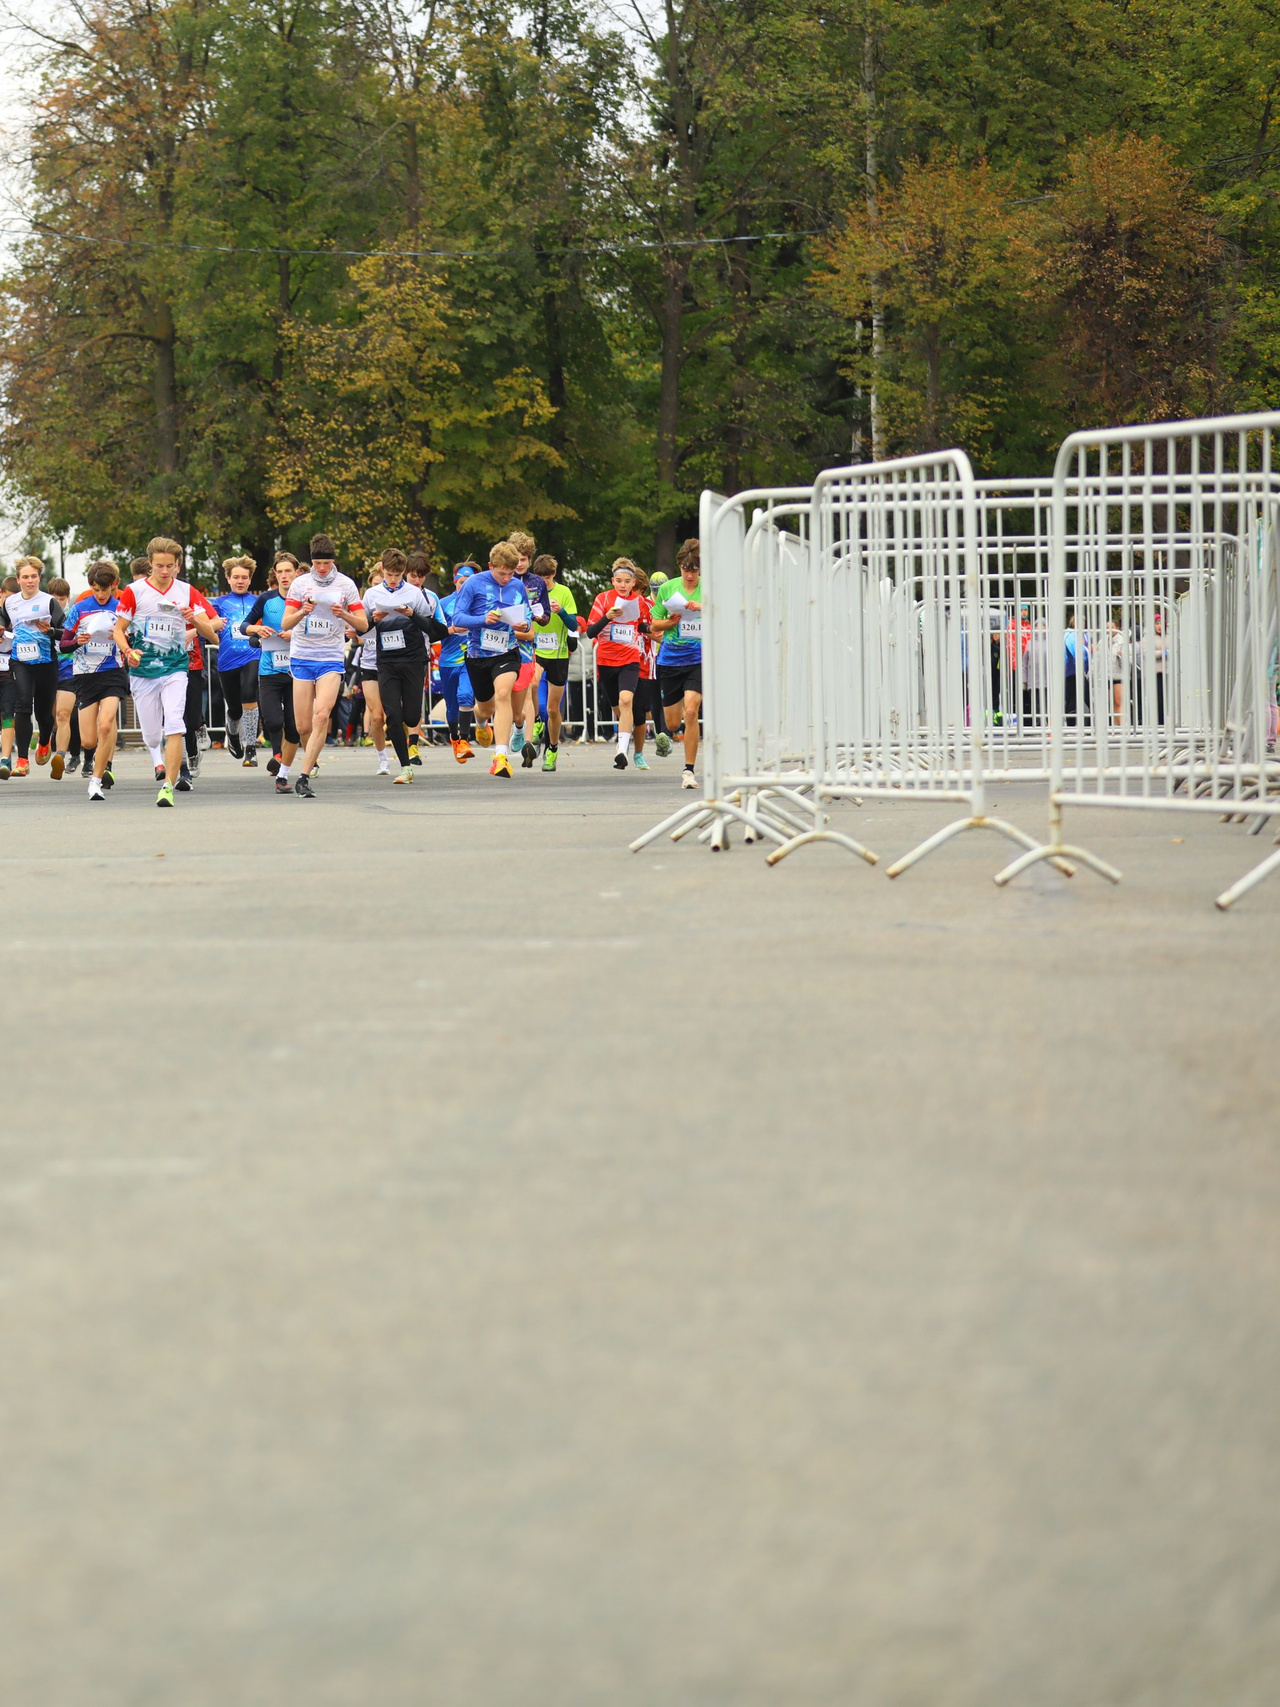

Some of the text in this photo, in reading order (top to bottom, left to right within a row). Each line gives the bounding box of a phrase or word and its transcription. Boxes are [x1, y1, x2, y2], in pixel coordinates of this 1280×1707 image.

[149, 622, 171, 631] 314.1
[310, 620, 329, 629] 318.1
[681, 623, 702, 631] 320.1
[614, 628, 632, 636] 340.1
[383, 635, 400, 643] 337.1
[484, 633, 505, 645] 339.1
